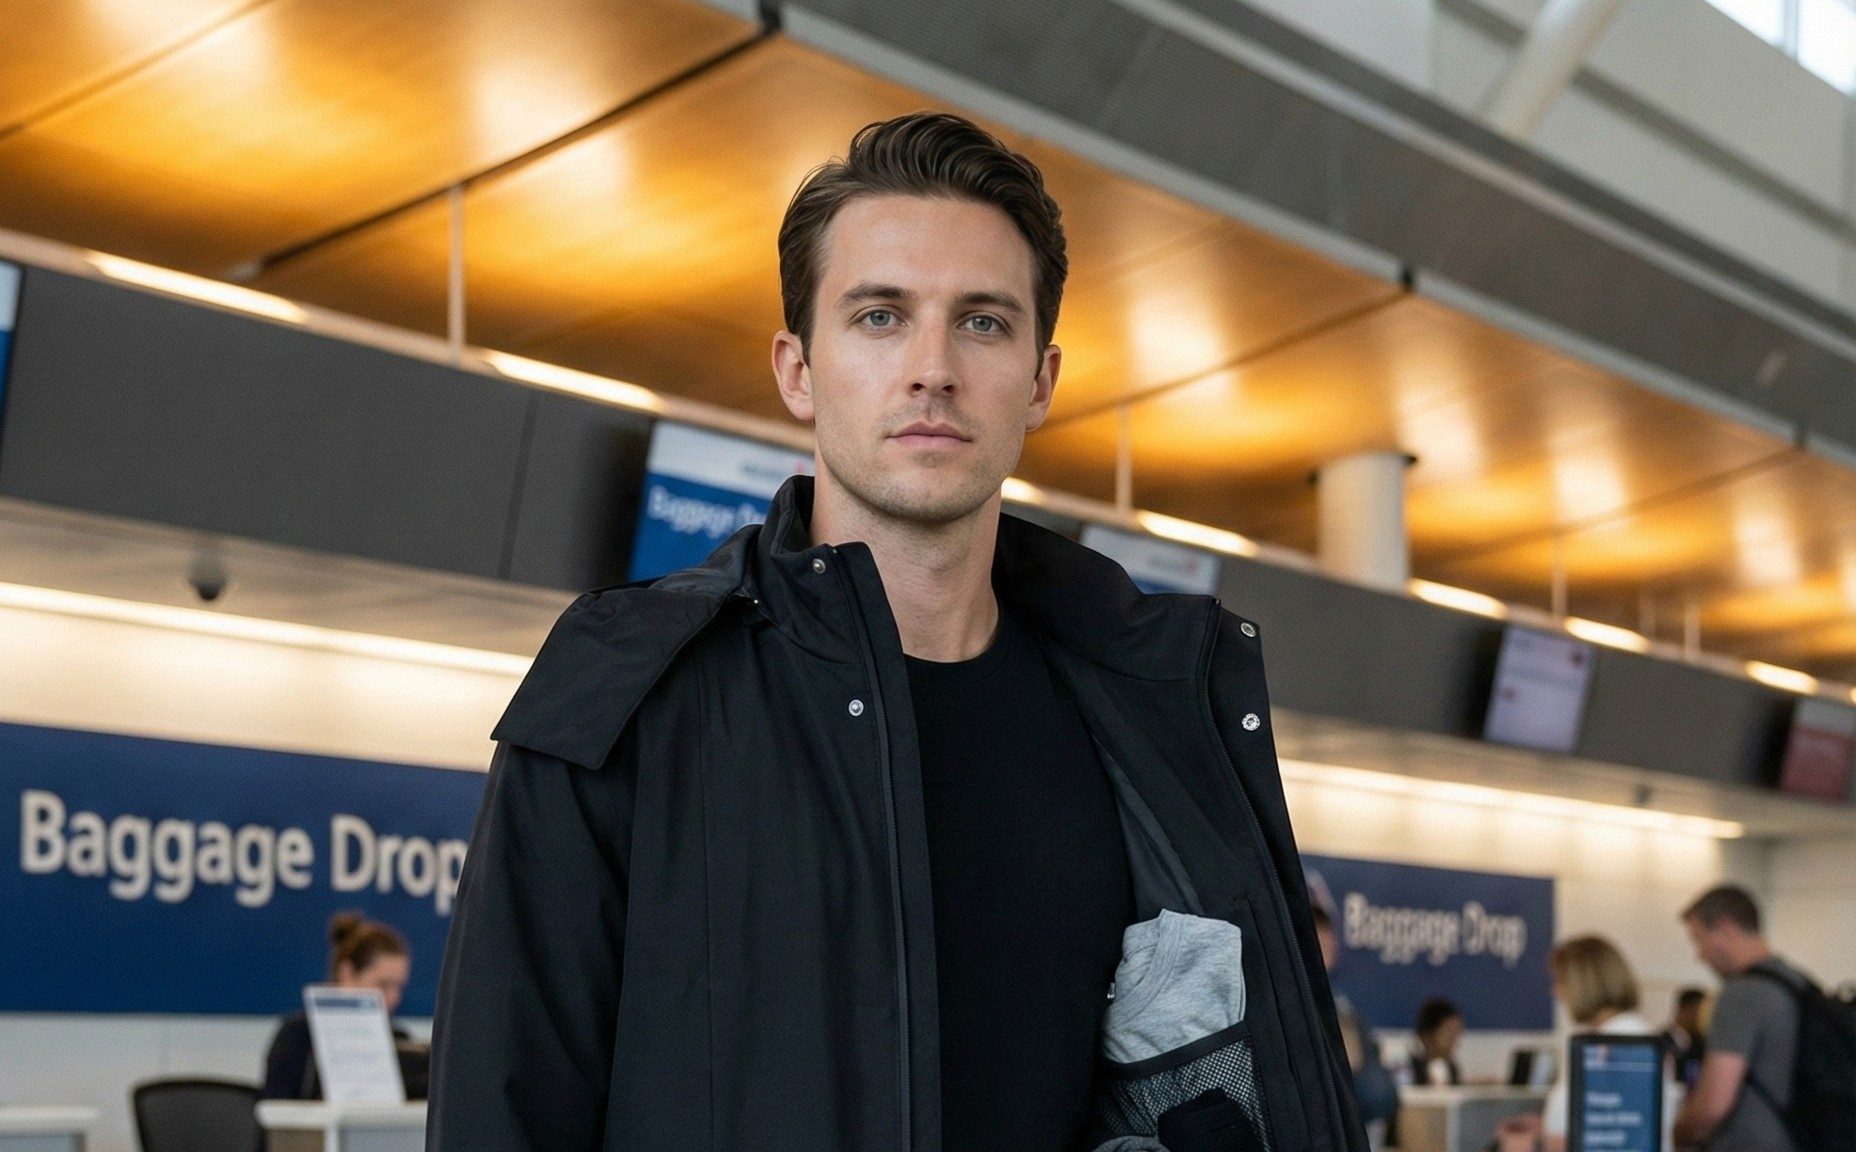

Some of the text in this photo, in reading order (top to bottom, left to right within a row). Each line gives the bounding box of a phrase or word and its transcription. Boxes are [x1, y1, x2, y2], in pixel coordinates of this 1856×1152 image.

[20, 788, 469, 917] Baggage Drop
[1343, 892, 1461, 967] Baggage
